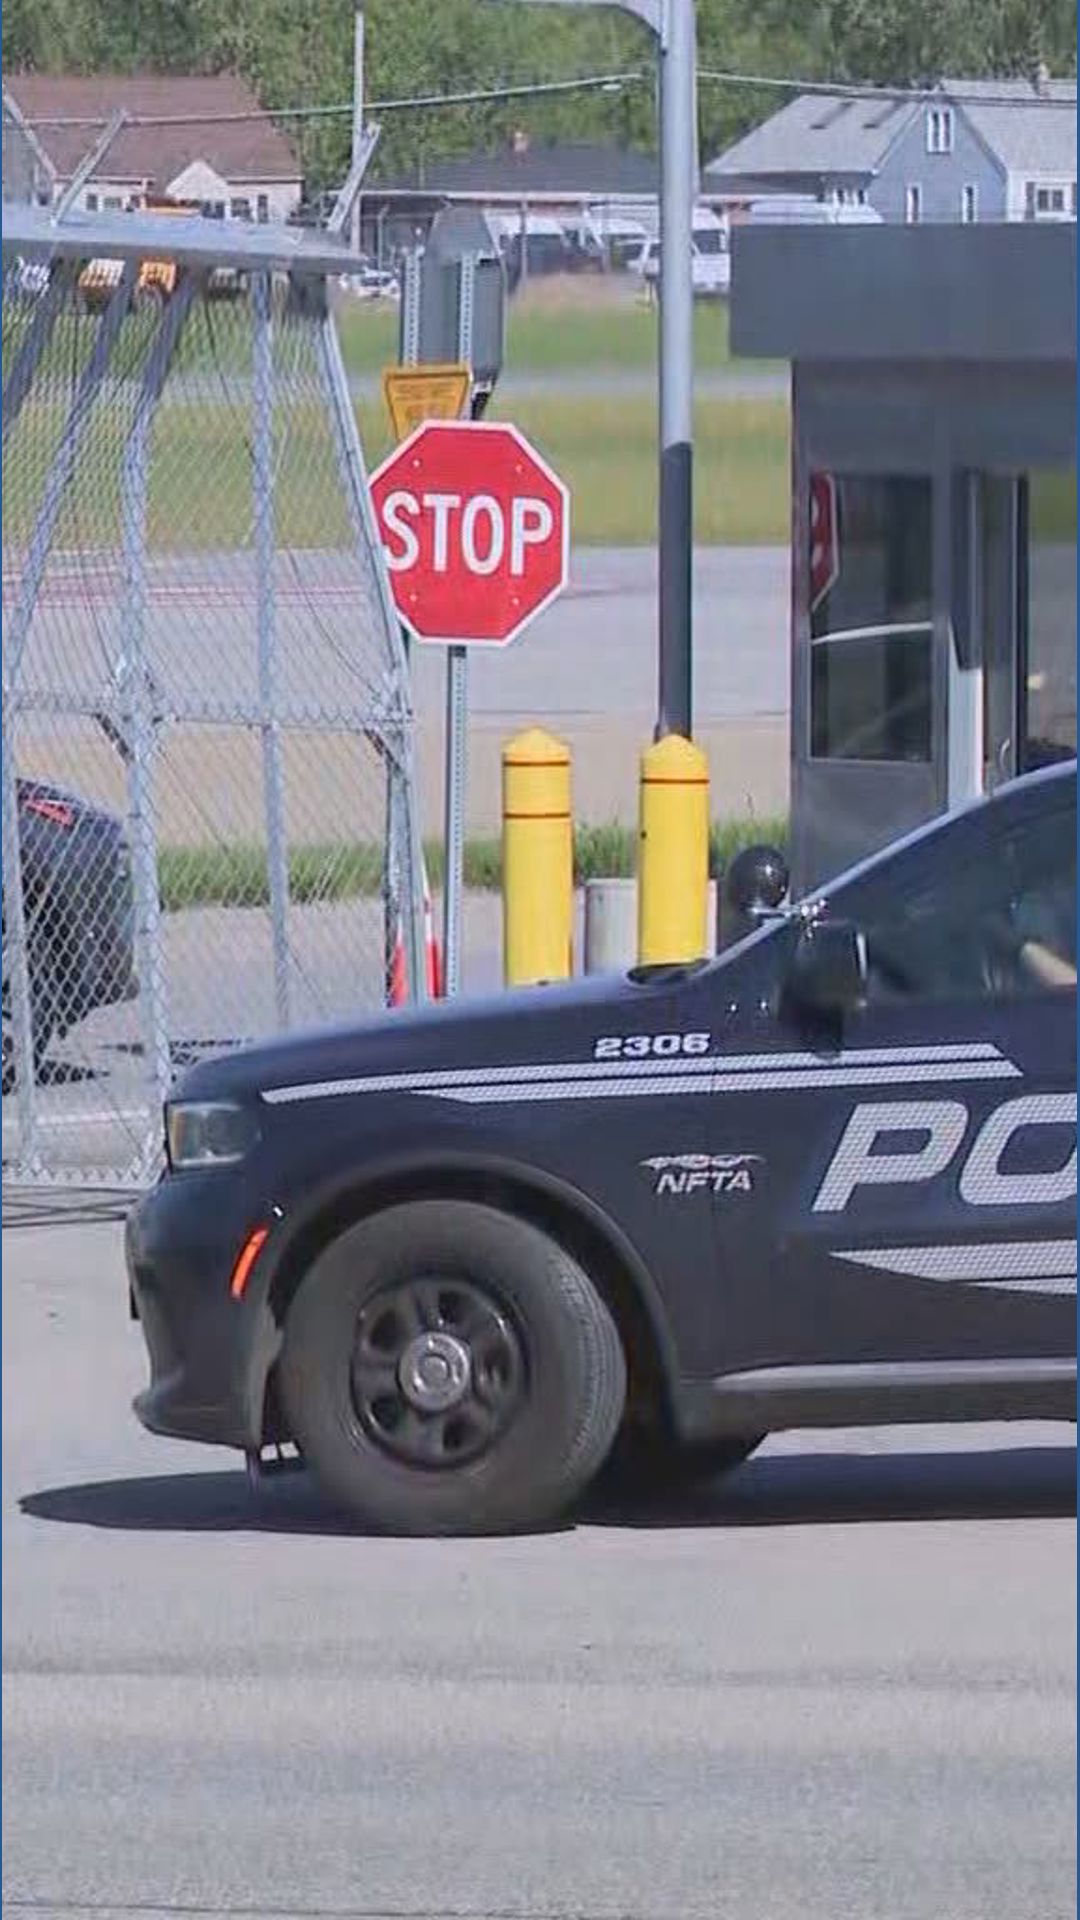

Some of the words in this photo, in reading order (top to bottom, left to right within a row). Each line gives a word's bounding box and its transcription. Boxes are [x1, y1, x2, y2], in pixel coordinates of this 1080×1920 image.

[382, 490, 553, 576] STOP
[594, 1033, 711, 1058] 2306
[812, 1093, 1078, 1212] PO
[656, 1170, 752, 1194] NFTA
